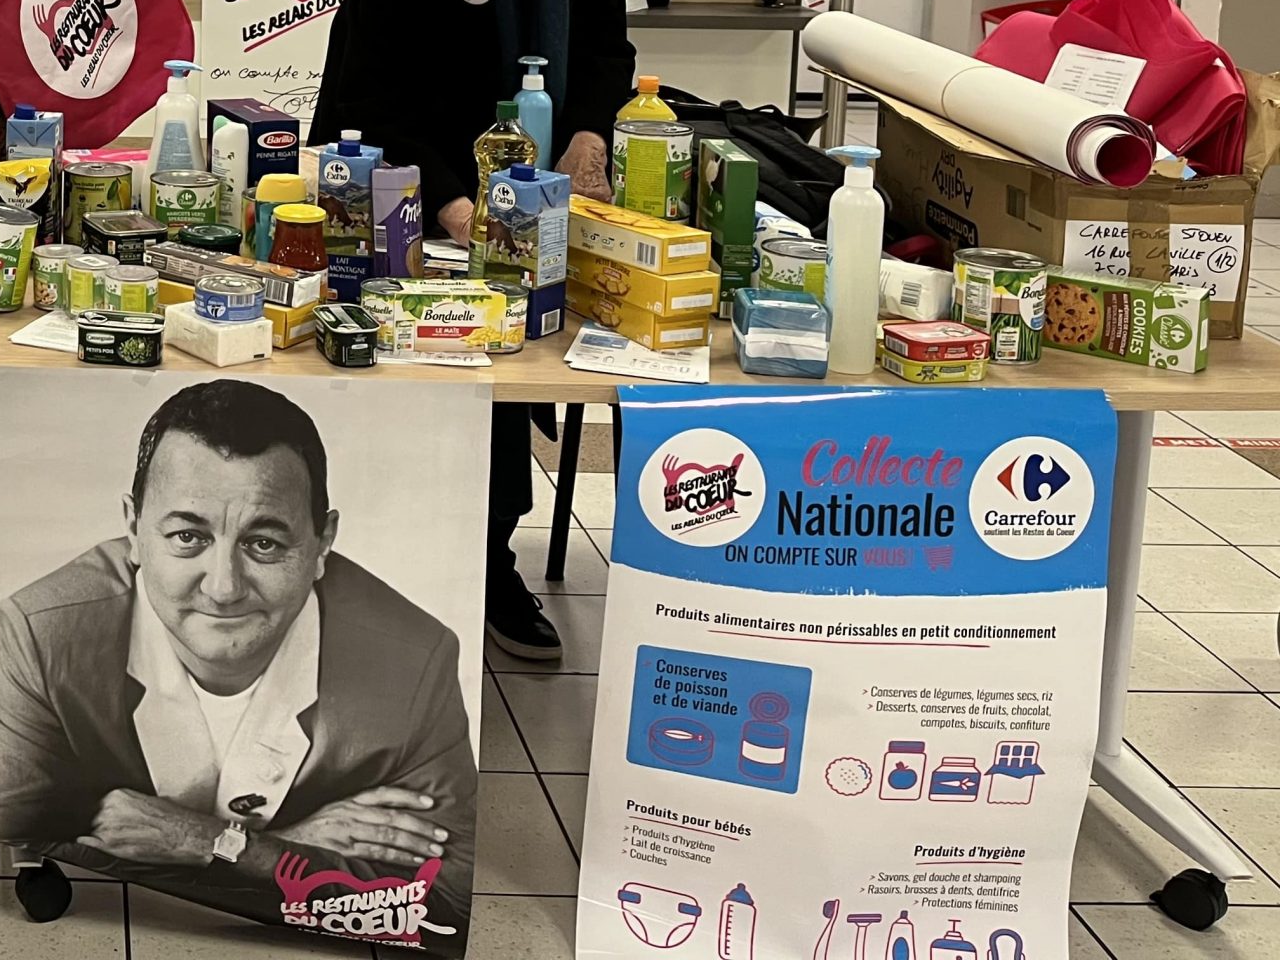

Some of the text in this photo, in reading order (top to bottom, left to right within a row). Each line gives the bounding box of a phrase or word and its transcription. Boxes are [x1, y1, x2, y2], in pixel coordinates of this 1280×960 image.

[242, 21, 265, 41] LES
[268, 1, 313, 32] RELAIS
[266, 135, 293, 144] Barilla
[326, 172, 347, 181] Extra
[932, 162, 973, 209] Agility
[1085, 245, 1105, 258] 16
[329, 265, 366, 274] MONTAGNE
[424, 309, 475, 323] Bonduelle
[1130, 299, 1146, 355] COOKIES
[801, 434, 964, 487] Collecte
[678, 465, 737, 493] RESTAURANTS
[665, 496, 682, 512] DU
[777, 491, 955, 538] Nationale
[985, 510, 1076, 525] Carrefour
[725, 545, 857, 566] ON COMPTE SUR
[656, 604, 1056, 640] Produits alimentaires non périssables en petit conditionnement
[656, 659, 728, 681] Conserves
[655, 676, 728, 698] de poisson
[871, 686, 1053, 702] Conserves de légumes, légumes secs, riz
[653, 693, 738, 716] et de viande
[876, 701, 1051, 716] Desserts, conserves de fruits, chocolat,
[921, 718, 1050, 730] compotes, biscuits, confiture
[627, 799, 752, 836] Produits pour bébés
[632, 825, 715, 852] Produits d'hygiène
[630, 848, 667, 866] Couches
[631, 837, 712, 864] Lait de croissance
[914, 845, 1026, 859] Produits d'hygiène
[878, 872, 1021, 885] Savons, gel douche et shampoing
[281, 880, 426, 914] LES RESTAURANTS
[868, 885, 1020, 898] Rasoirs, brosses à dents, dentifrice
[922, 897, 1018, 913] Protections féminines
[284, 915, 317, 926] DU
